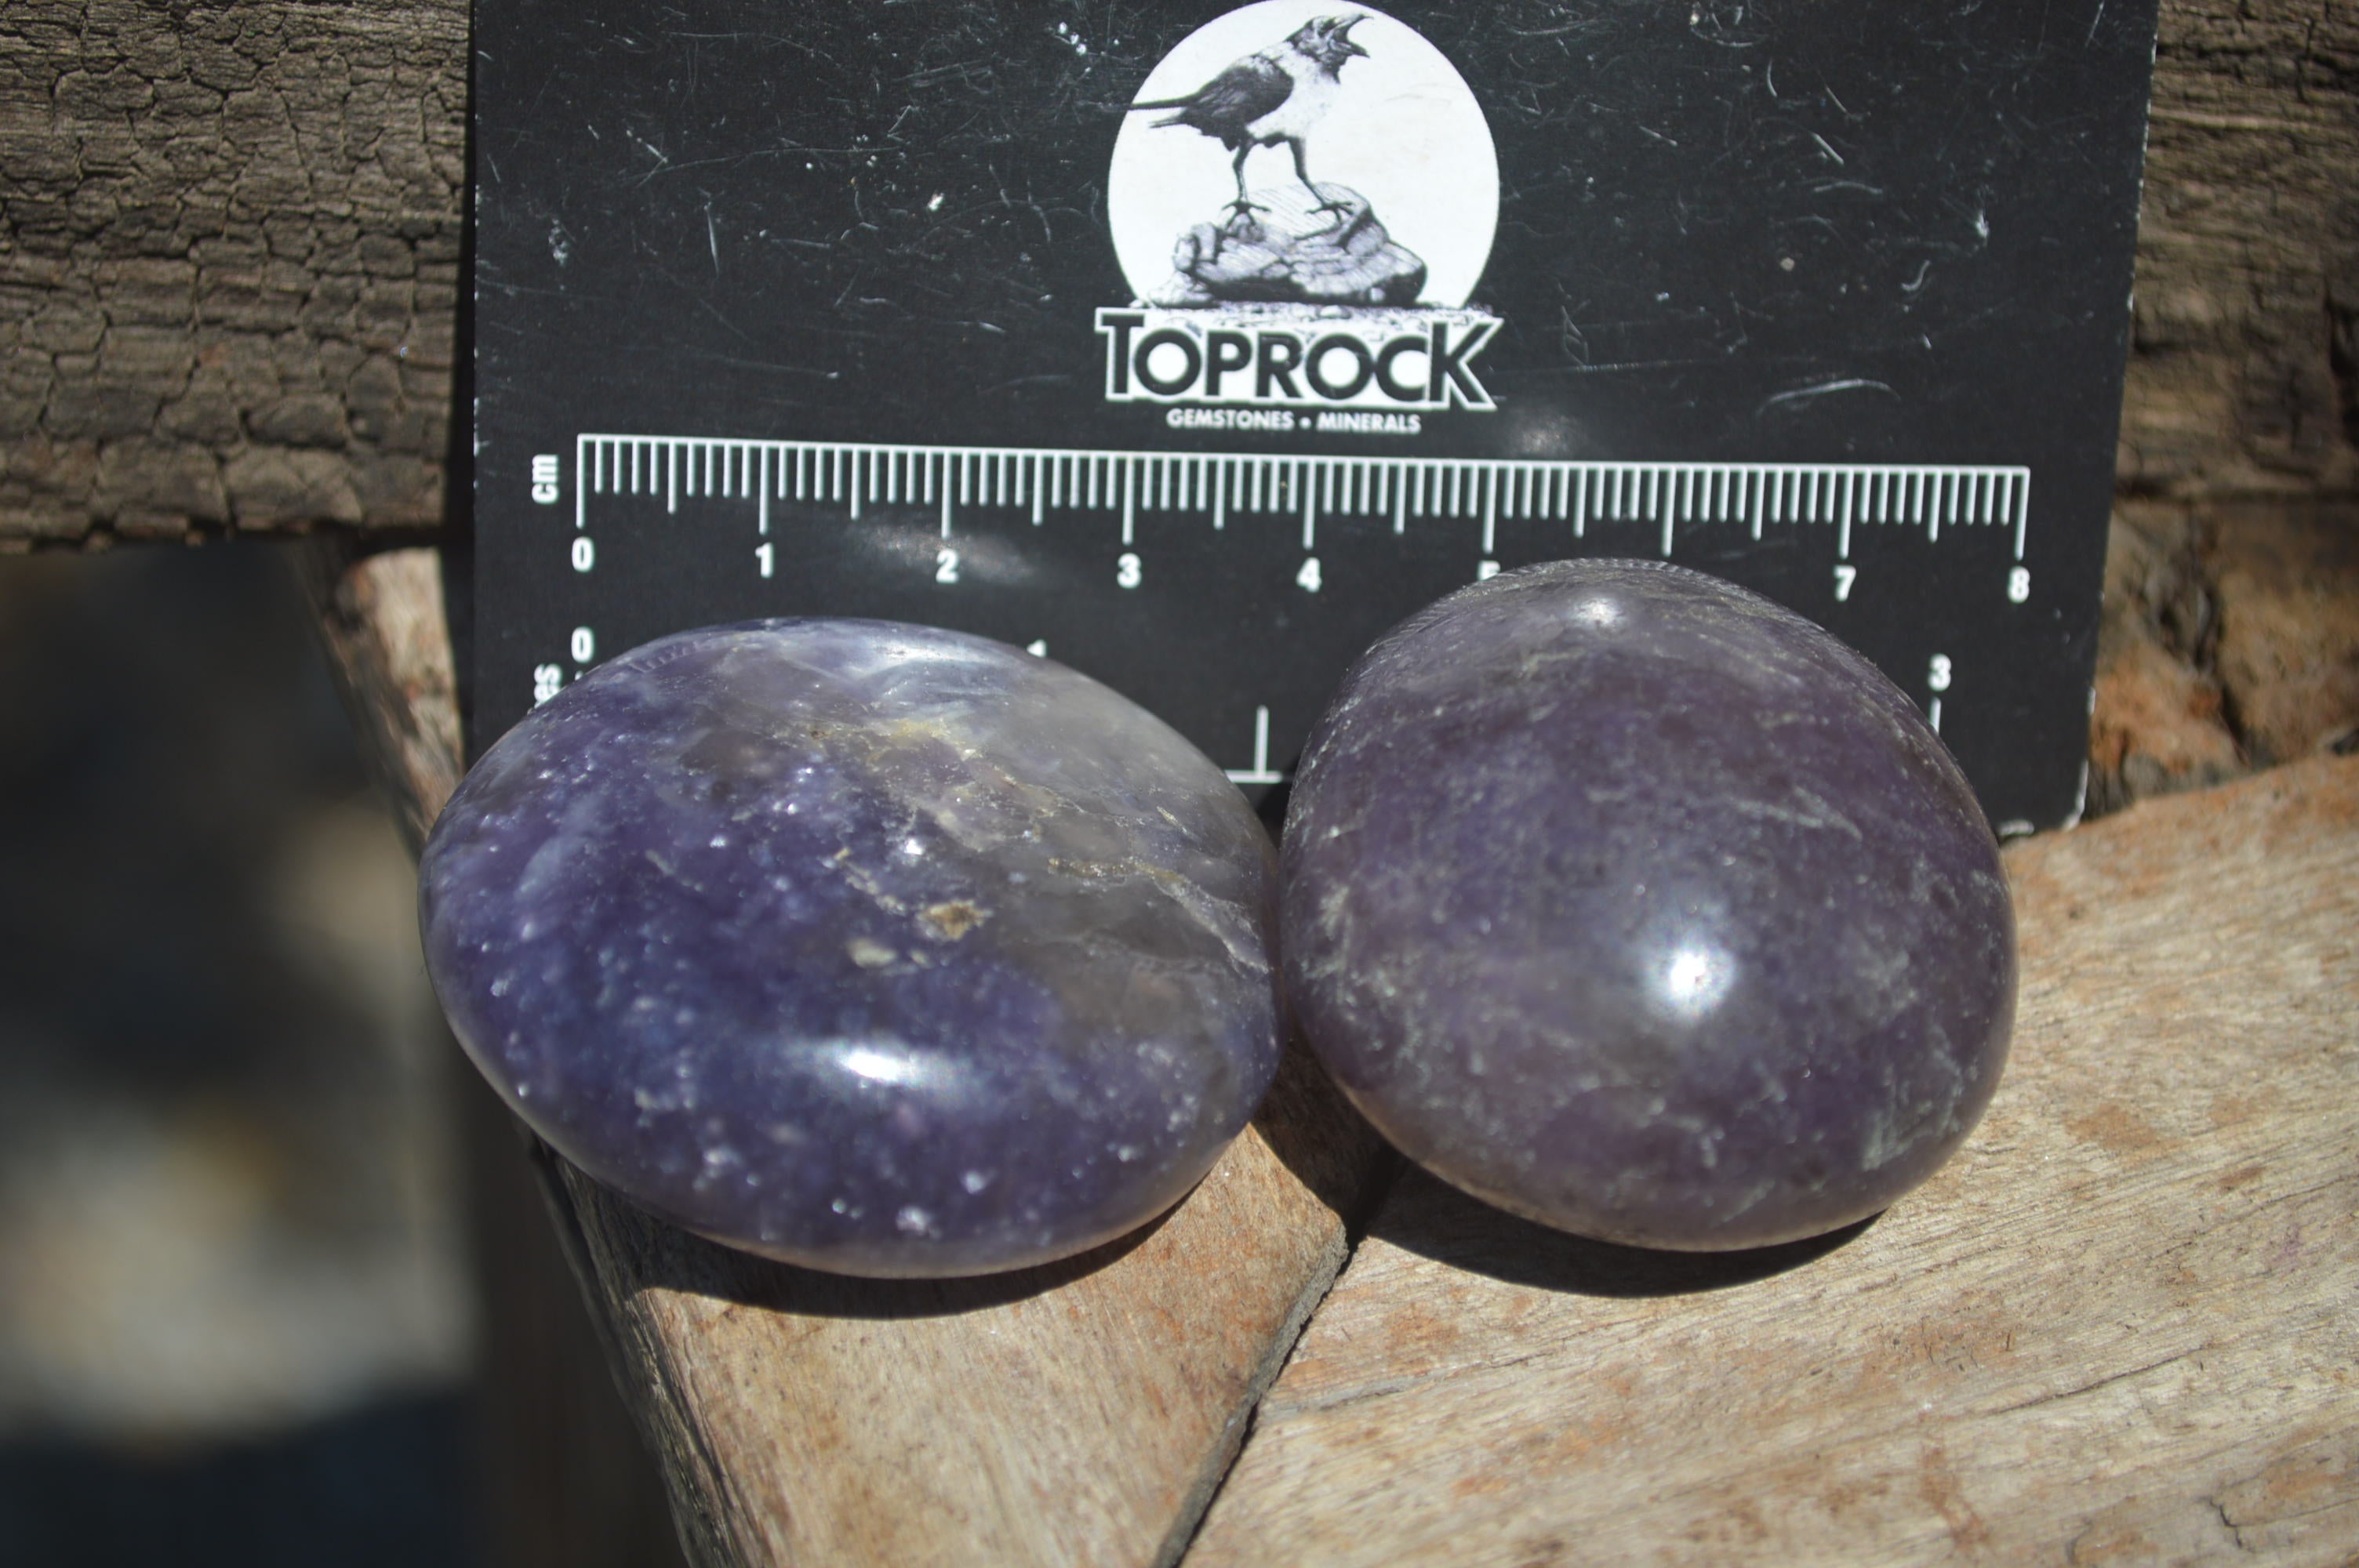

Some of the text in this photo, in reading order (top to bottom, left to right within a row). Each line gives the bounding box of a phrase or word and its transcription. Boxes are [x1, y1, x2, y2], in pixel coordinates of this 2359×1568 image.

[1093, 307, 1504, 412] TOPROCK
[1165, 407, 1422, 435] GEMSTONES MINERALS
[531, 453, 559, 505] cm
[571, 537, 594, 573] 0
[754, 543, 773, 578] 1
[934, 545, 960, 583] 2
[1116, 553, 1142, 589] 3
[1296, 557, 1322, 593] 4
[1834, 564, 1856, 601] 7
[2008, 566, 2030, 604] 8
[571, 626, 1951, 691] 0 3
